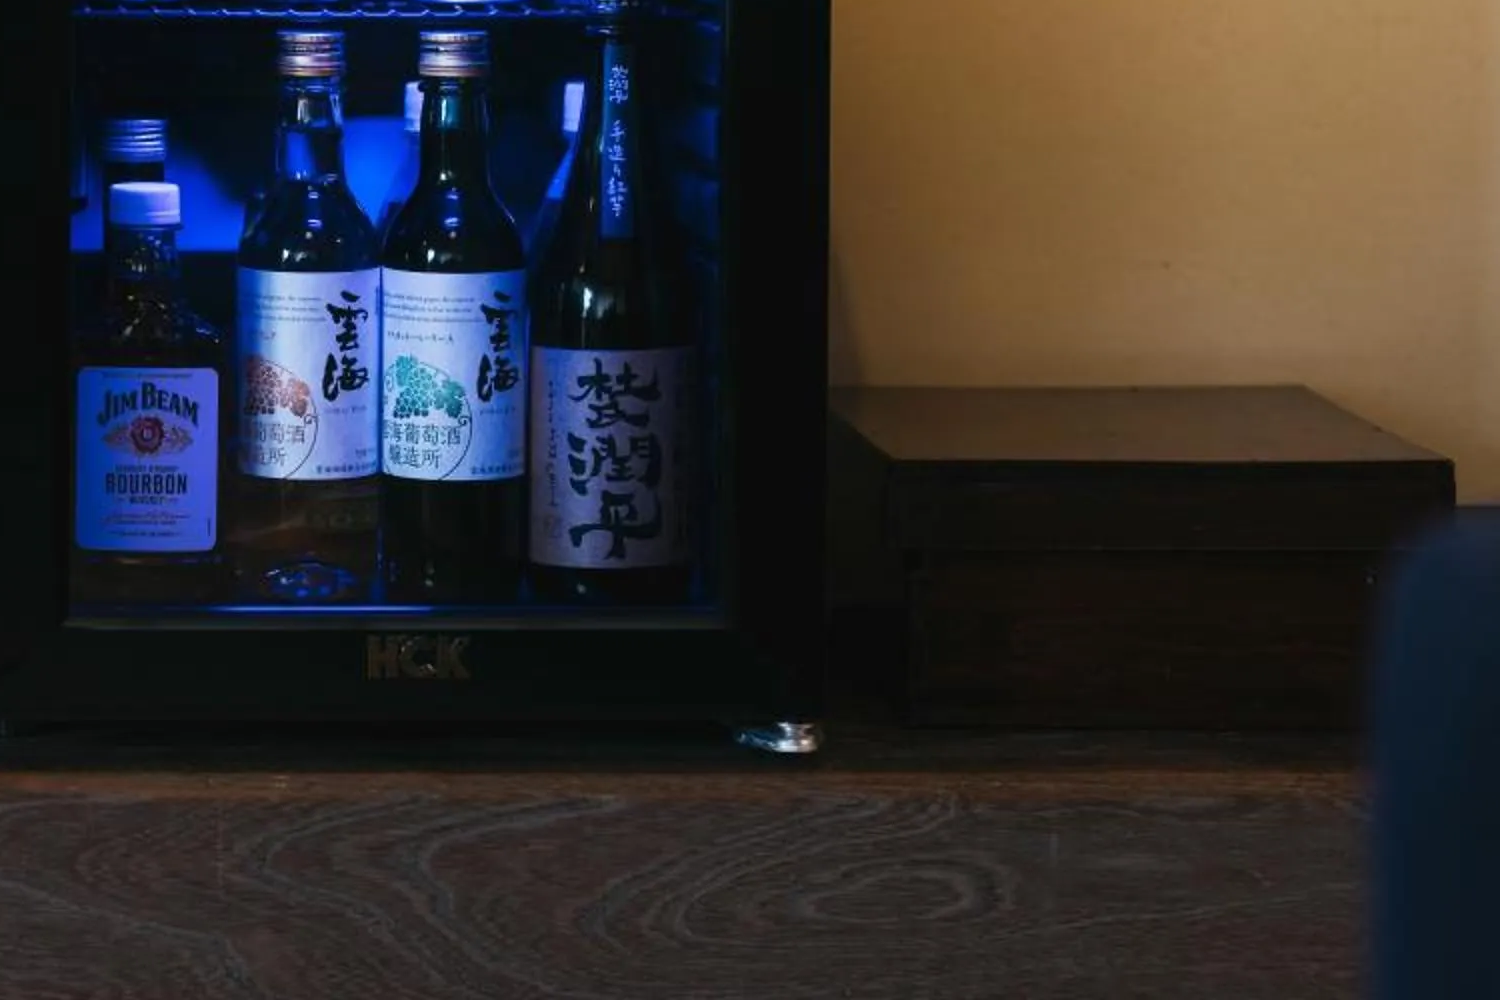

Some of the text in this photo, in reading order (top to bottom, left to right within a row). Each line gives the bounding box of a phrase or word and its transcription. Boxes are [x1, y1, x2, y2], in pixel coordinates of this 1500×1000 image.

[322, 290, 369, 403] 雲海
[476, 290, 520, 403] 雲海
[97, 381, 200, 427] JIM BEAM
[105, 472, 188, 495] BOURBON
[366, 634, 472, 680] HCK
